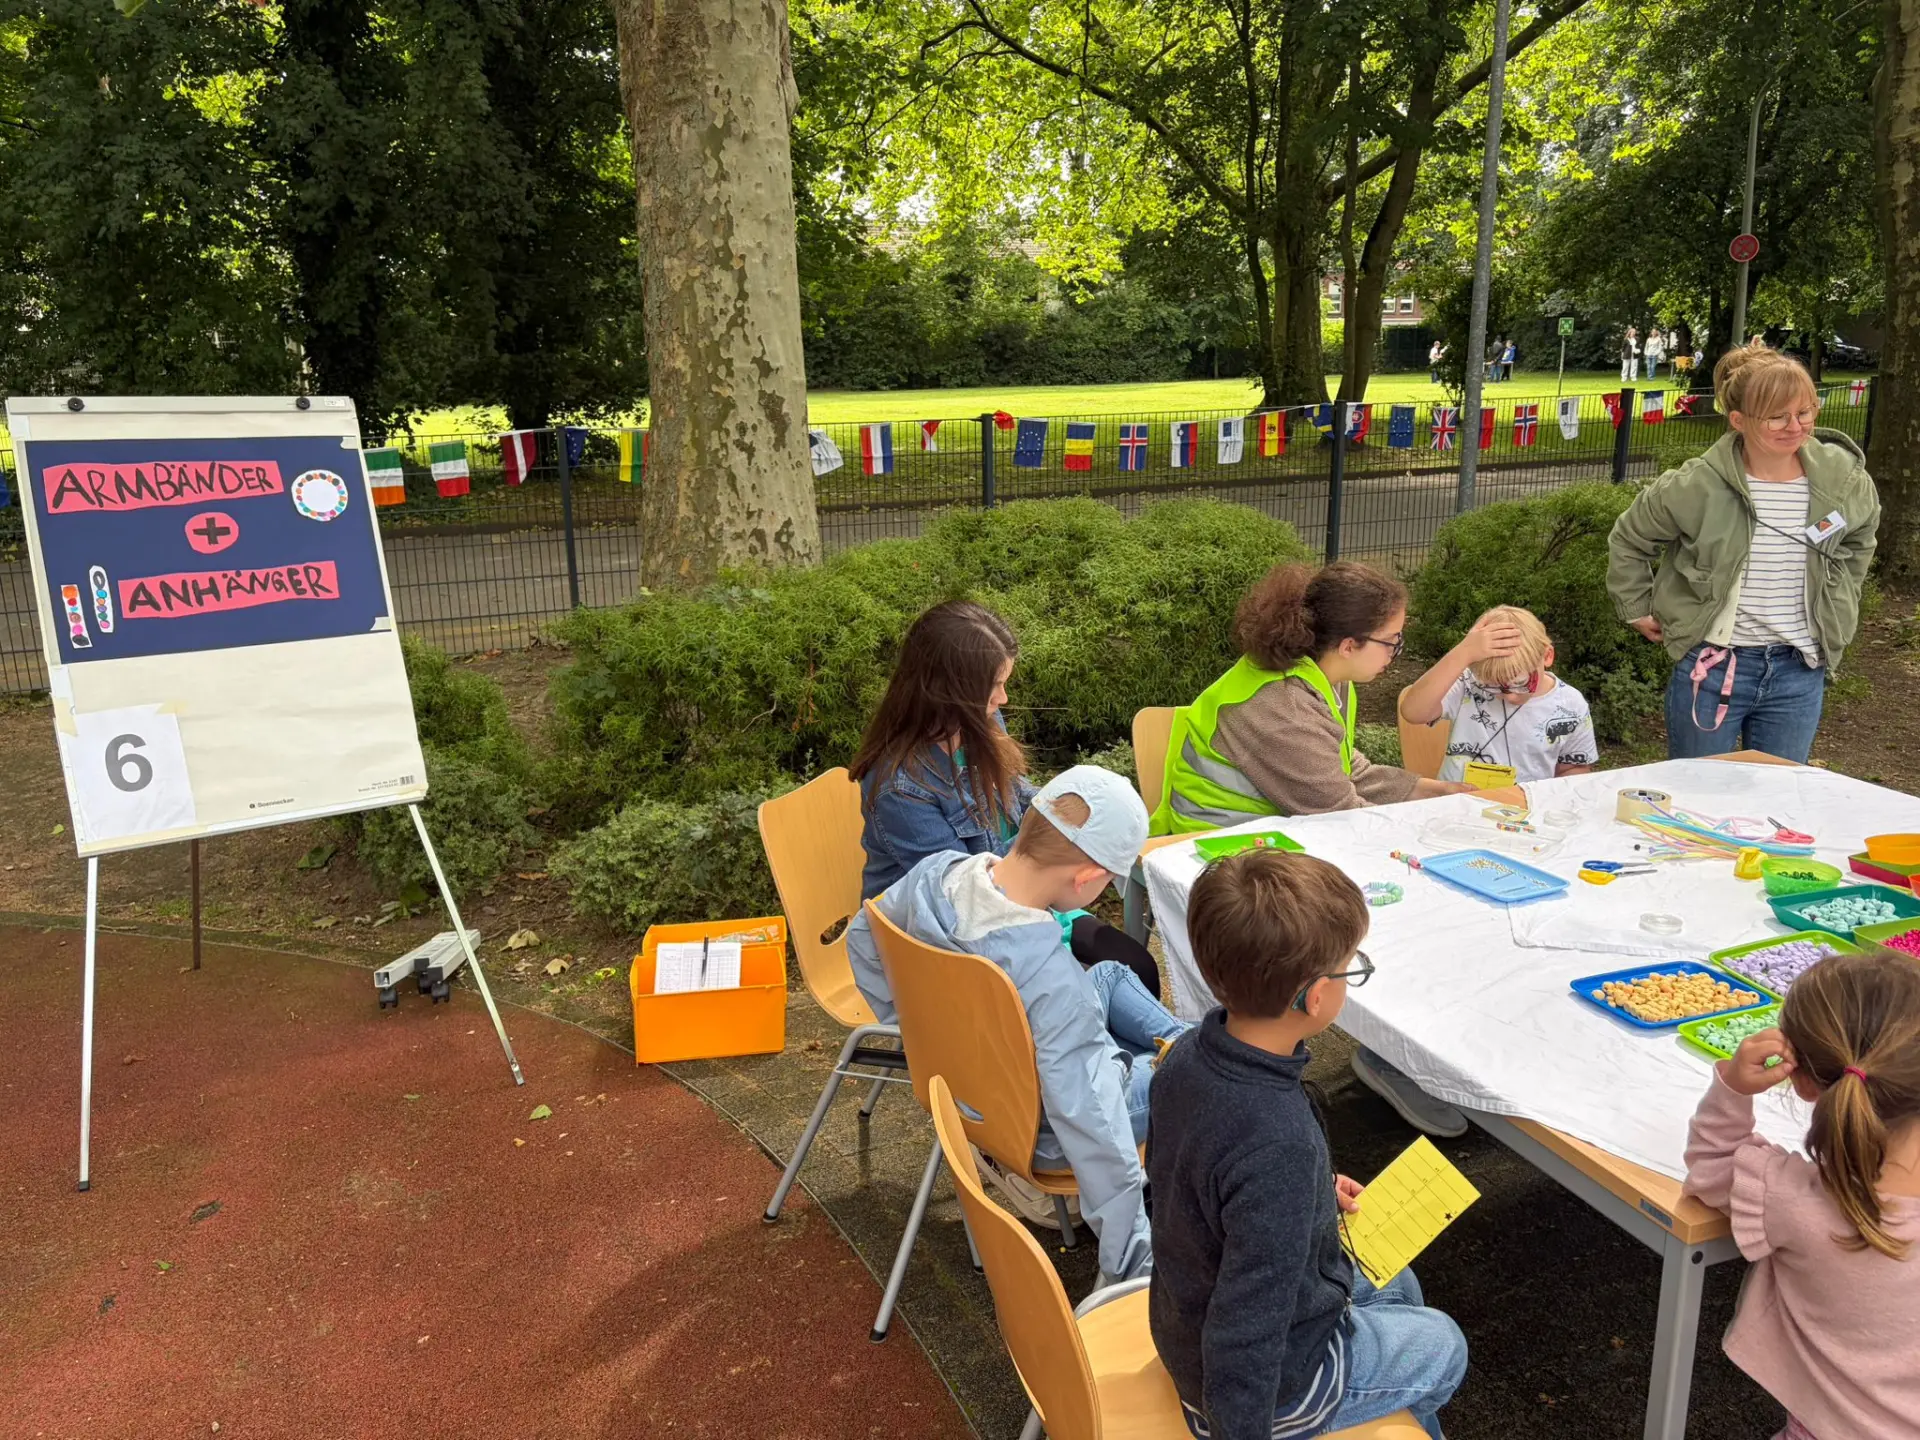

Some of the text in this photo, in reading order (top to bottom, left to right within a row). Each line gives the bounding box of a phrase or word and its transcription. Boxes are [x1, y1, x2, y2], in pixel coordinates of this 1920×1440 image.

[52, 461, 275, 509] ARMBÄNDER
[129, 565, 333, 613] ANHÄNGER
[105, 733, 153, 792] 6
